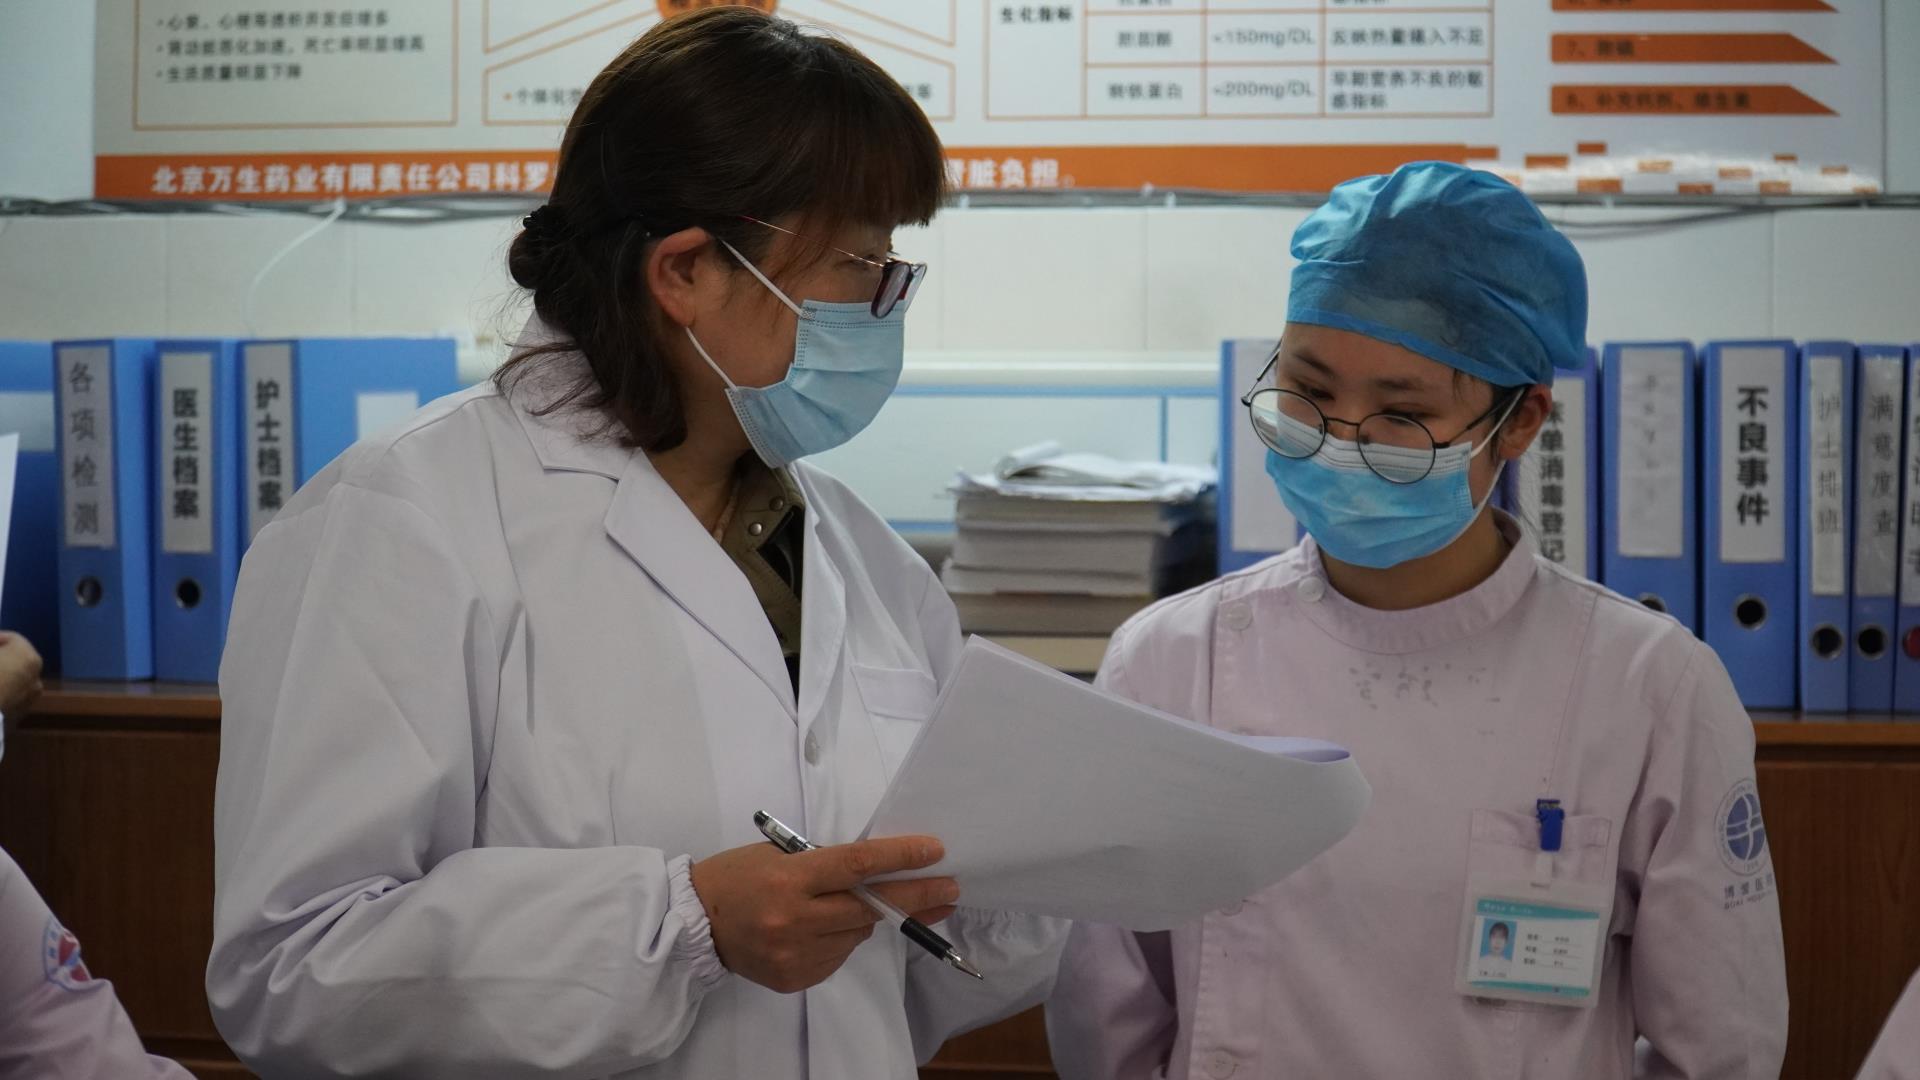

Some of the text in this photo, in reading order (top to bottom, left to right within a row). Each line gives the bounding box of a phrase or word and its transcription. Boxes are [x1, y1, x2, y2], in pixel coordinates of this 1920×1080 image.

[1000, 5, 1072, 23] 生化指标
[151, 162, 550, 195] 北京万生药业有限责任公司科罗
[69, 361, 99, 535] 各项检测
[173, 388, 200, 519] 医生档案
[255, 378, 283, 511] 护士档案
[1737, 386, 1770, 526] 不良事件
[1816, 391, 1841, 535] 护士排班
[1868, 392, 1895, 537] 满意度查
